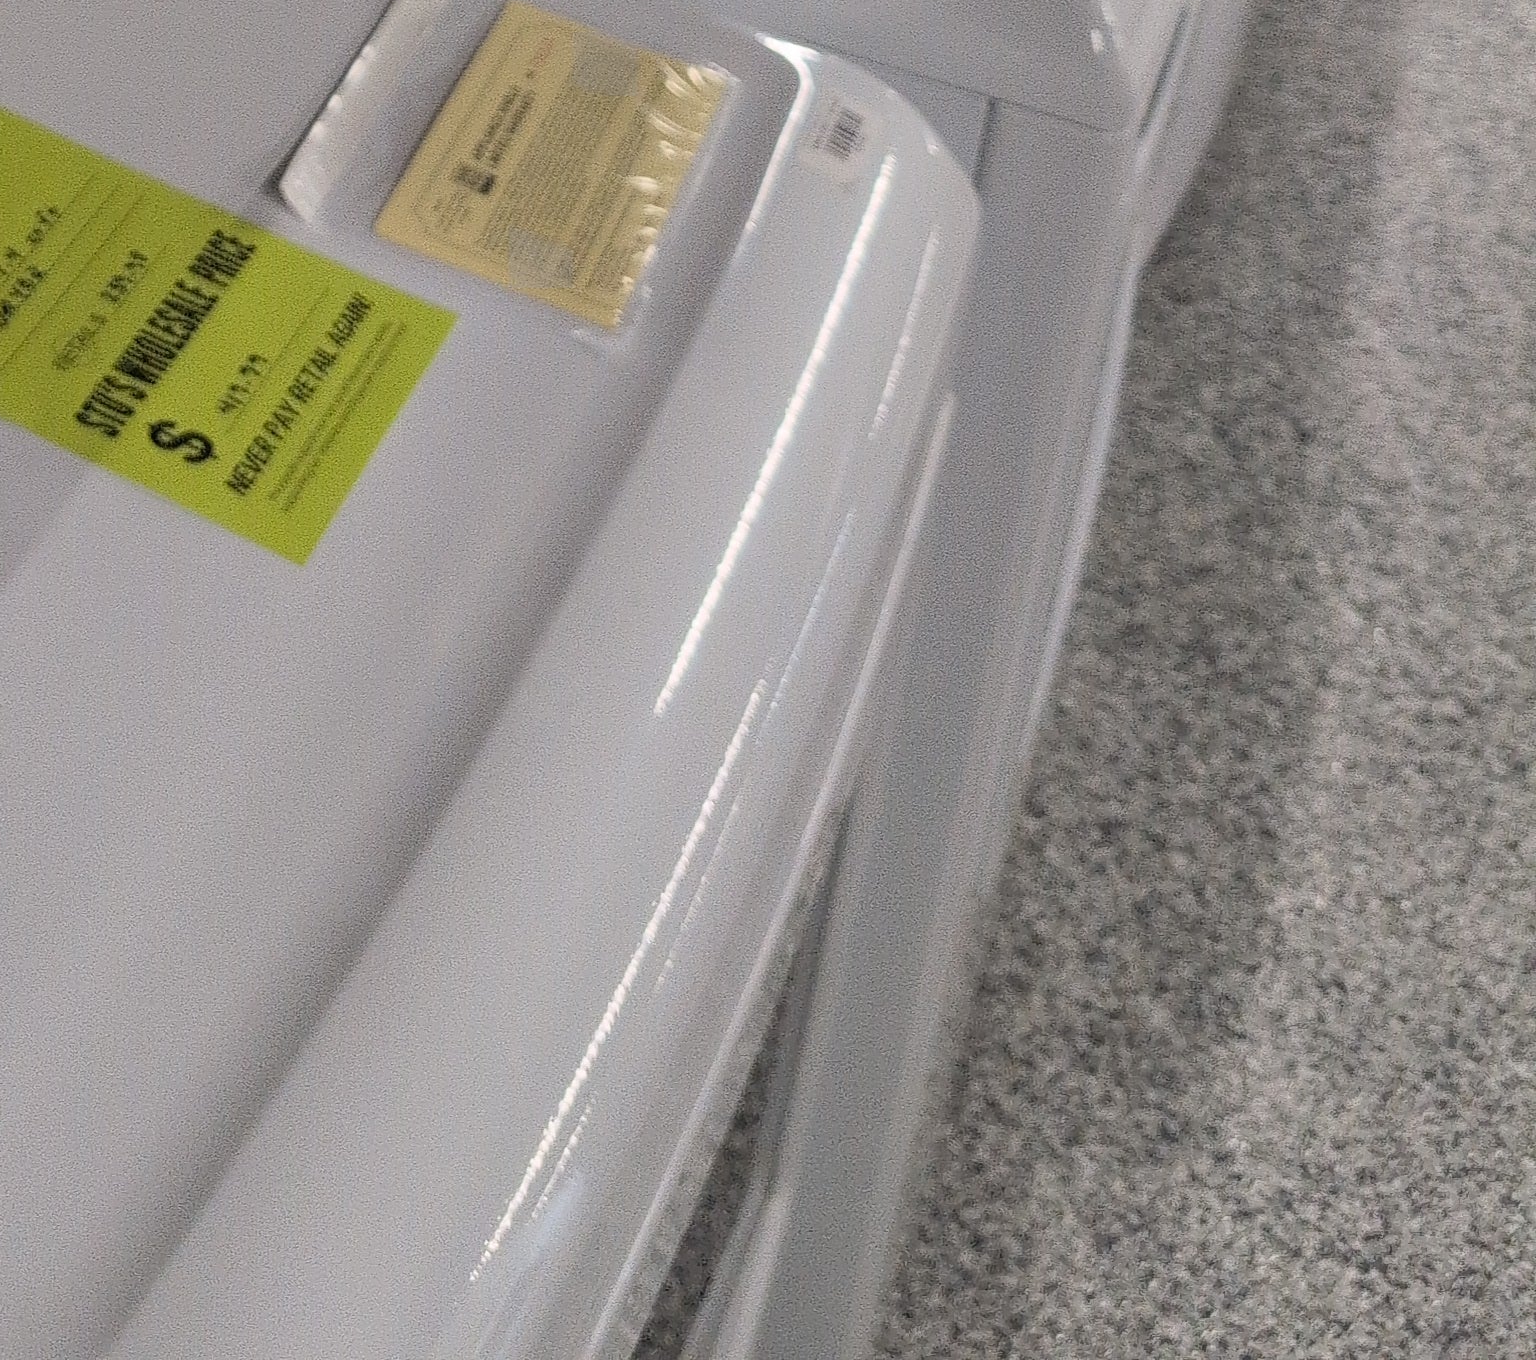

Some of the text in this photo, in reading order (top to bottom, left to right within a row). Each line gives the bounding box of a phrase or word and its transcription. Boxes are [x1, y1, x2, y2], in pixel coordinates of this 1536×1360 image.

[72, 228, 257, 440] STU'S WHOLESALE PRICE
[144, 416, 219, 469] $
[223, 434, 279, 496] NEVER
[262, 398, 303, 439] PAY
[285, 344, 339, 403] RETAIL
